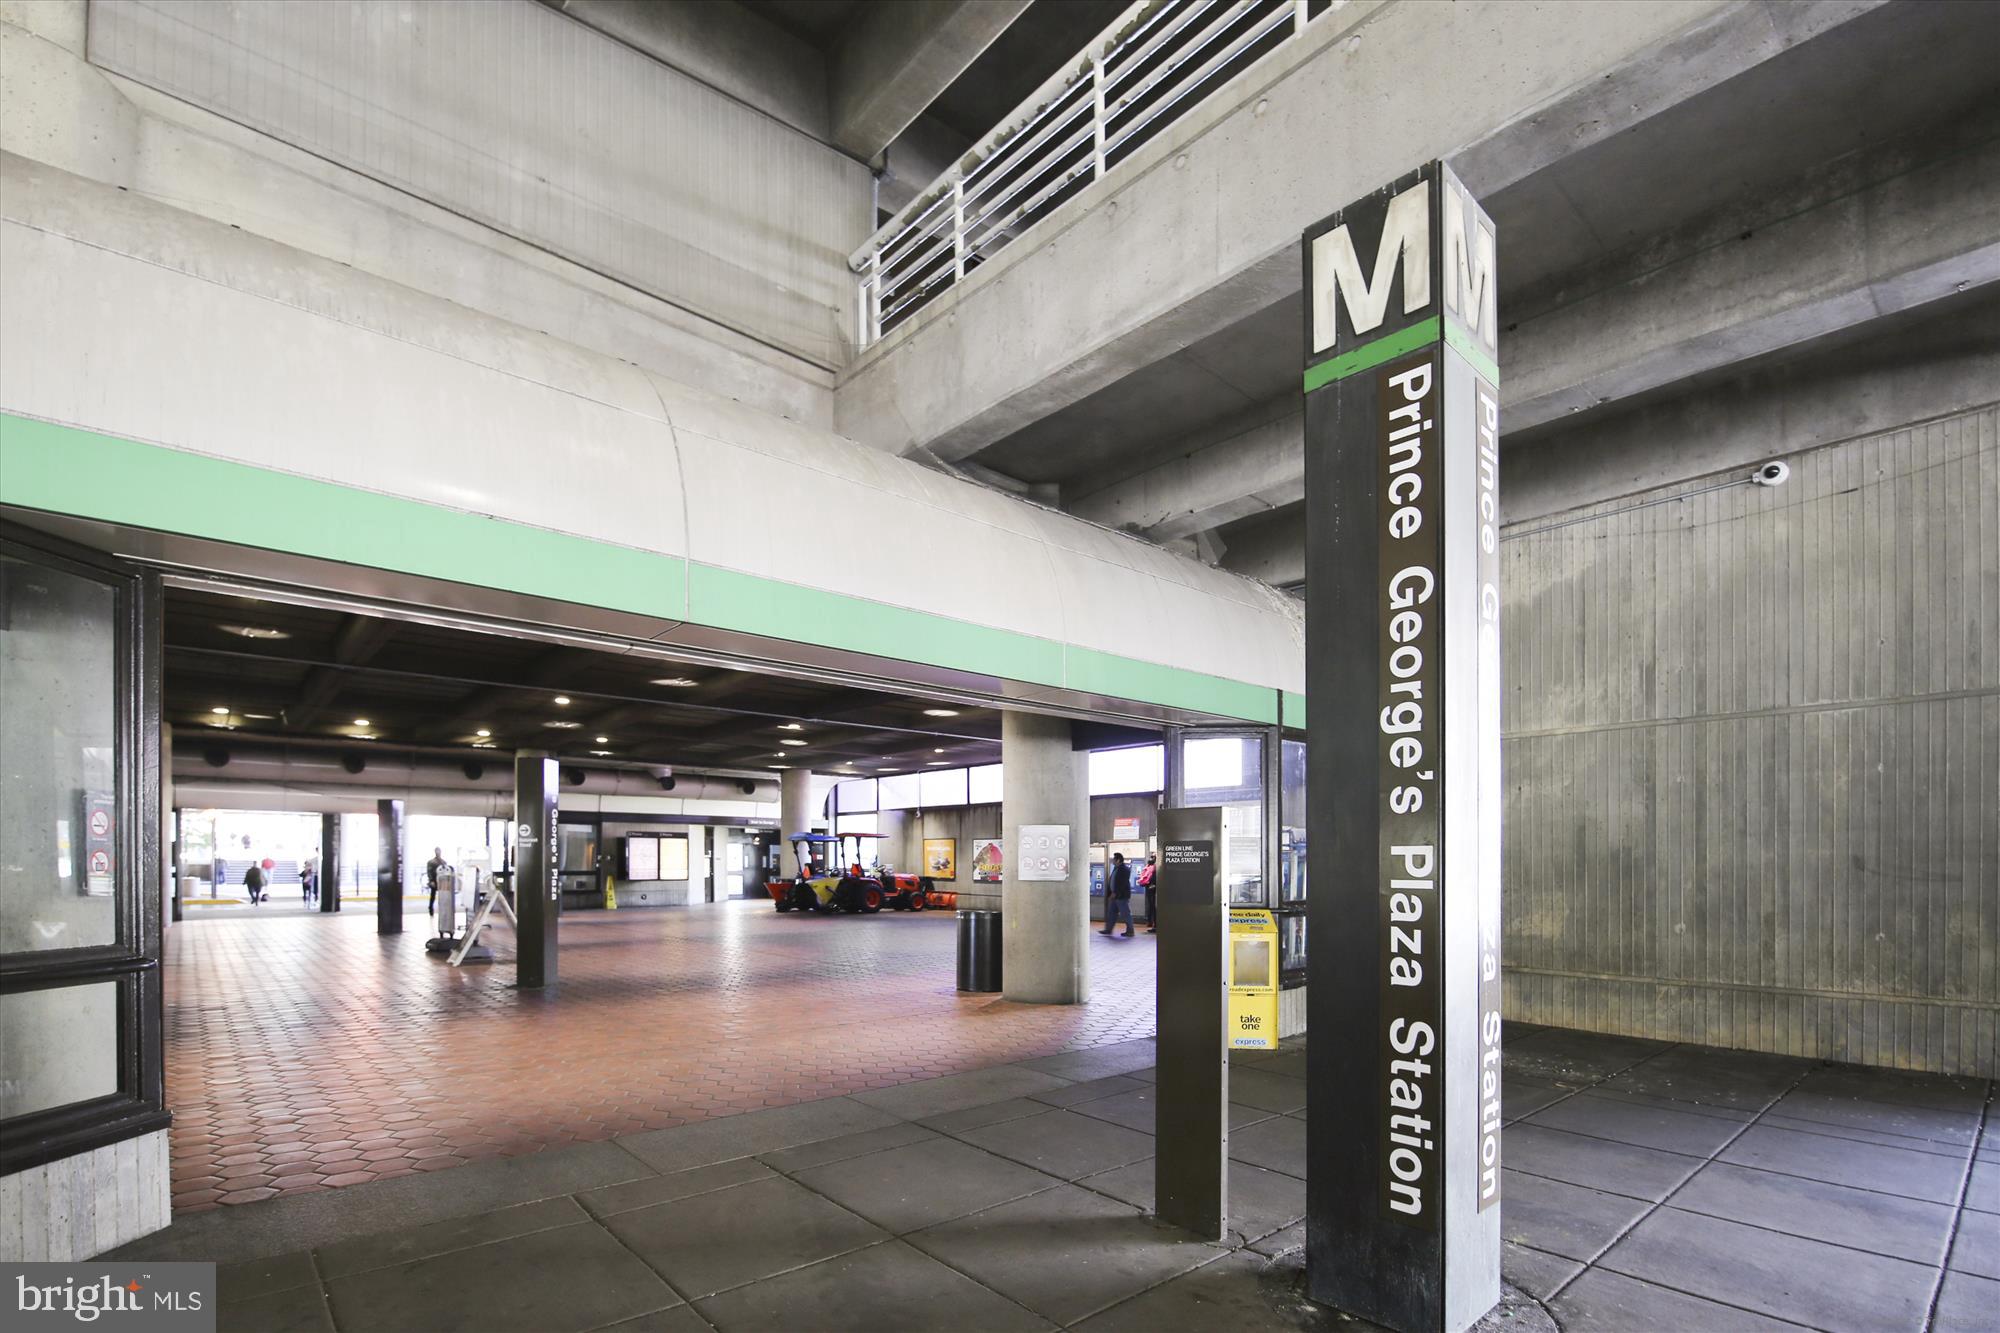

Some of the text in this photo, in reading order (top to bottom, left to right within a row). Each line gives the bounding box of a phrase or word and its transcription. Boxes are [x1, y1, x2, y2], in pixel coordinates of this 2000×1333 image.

[1312, 179, 1431, 354] M
[1446, 182, 1496, 352] M
[1480, 391, 1498, 555] Prince
[1379, 362, 1435, 1216] Prince George's Plaza Station
[551, 868, 559, 901] Plaza
[1240, 1014, 1262, 1024] take
[1241, 1023, 1261, 1031] one
[1482, 1010, 1501, 1200] Station
